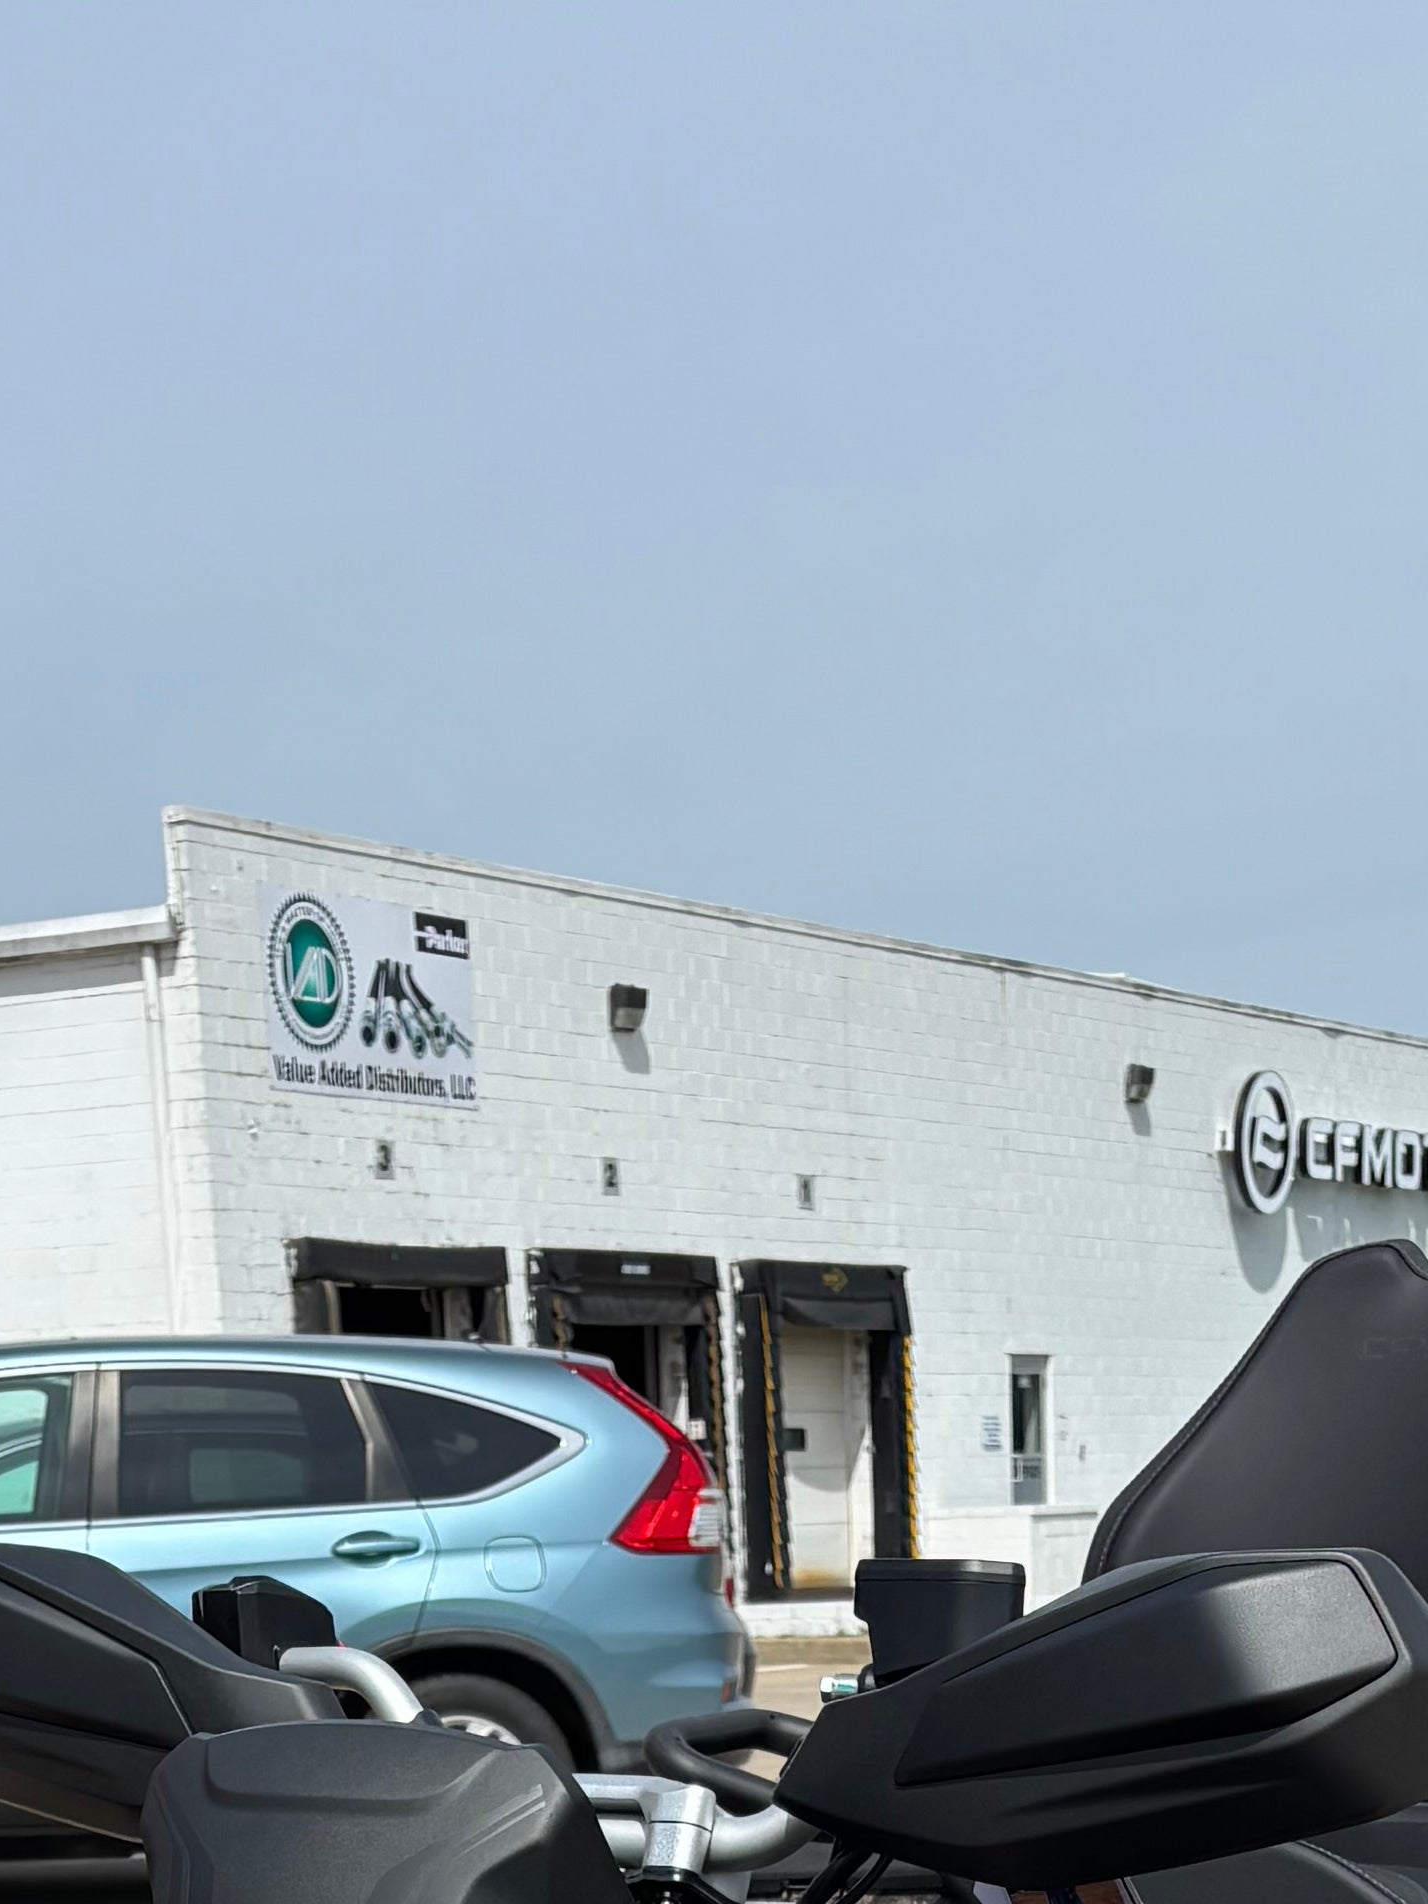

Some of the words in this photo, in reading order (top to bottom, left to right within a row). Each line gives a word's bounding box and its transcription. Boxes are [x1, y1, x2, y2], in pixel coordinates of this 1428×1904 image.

[272, 1054, 316, 1084] Value
[318, 1060, 363, 1089] Added
[376, 1144, 392, 1172] 3
[604, 1163, 618, 1188] 2
